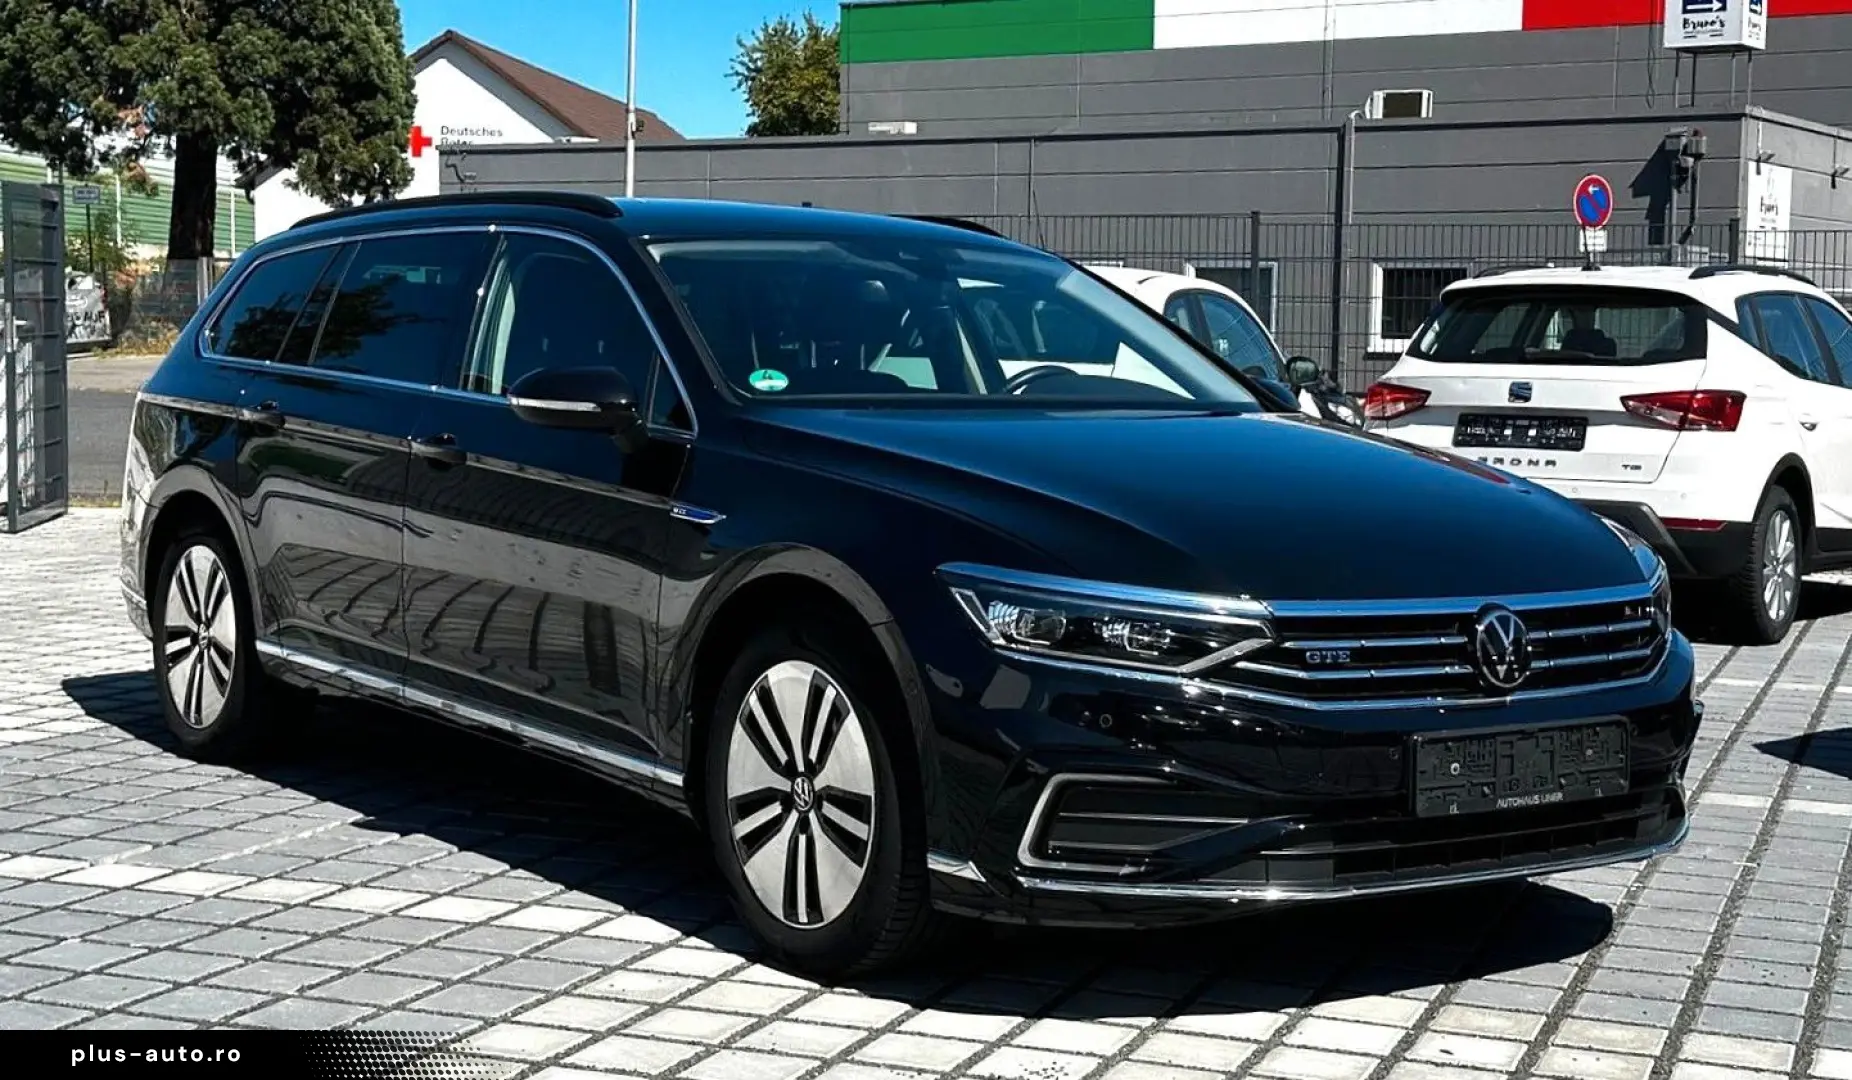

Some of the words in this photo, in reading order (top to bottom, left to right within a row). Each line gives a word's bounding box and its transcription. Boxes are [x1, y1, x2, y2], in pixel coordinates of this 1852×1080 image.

[440, 125, 503, 137] Deutsches
[1305, 650, 1351, 664] GTE
[1496, 794, 1541, 809] AUTOHAUS
